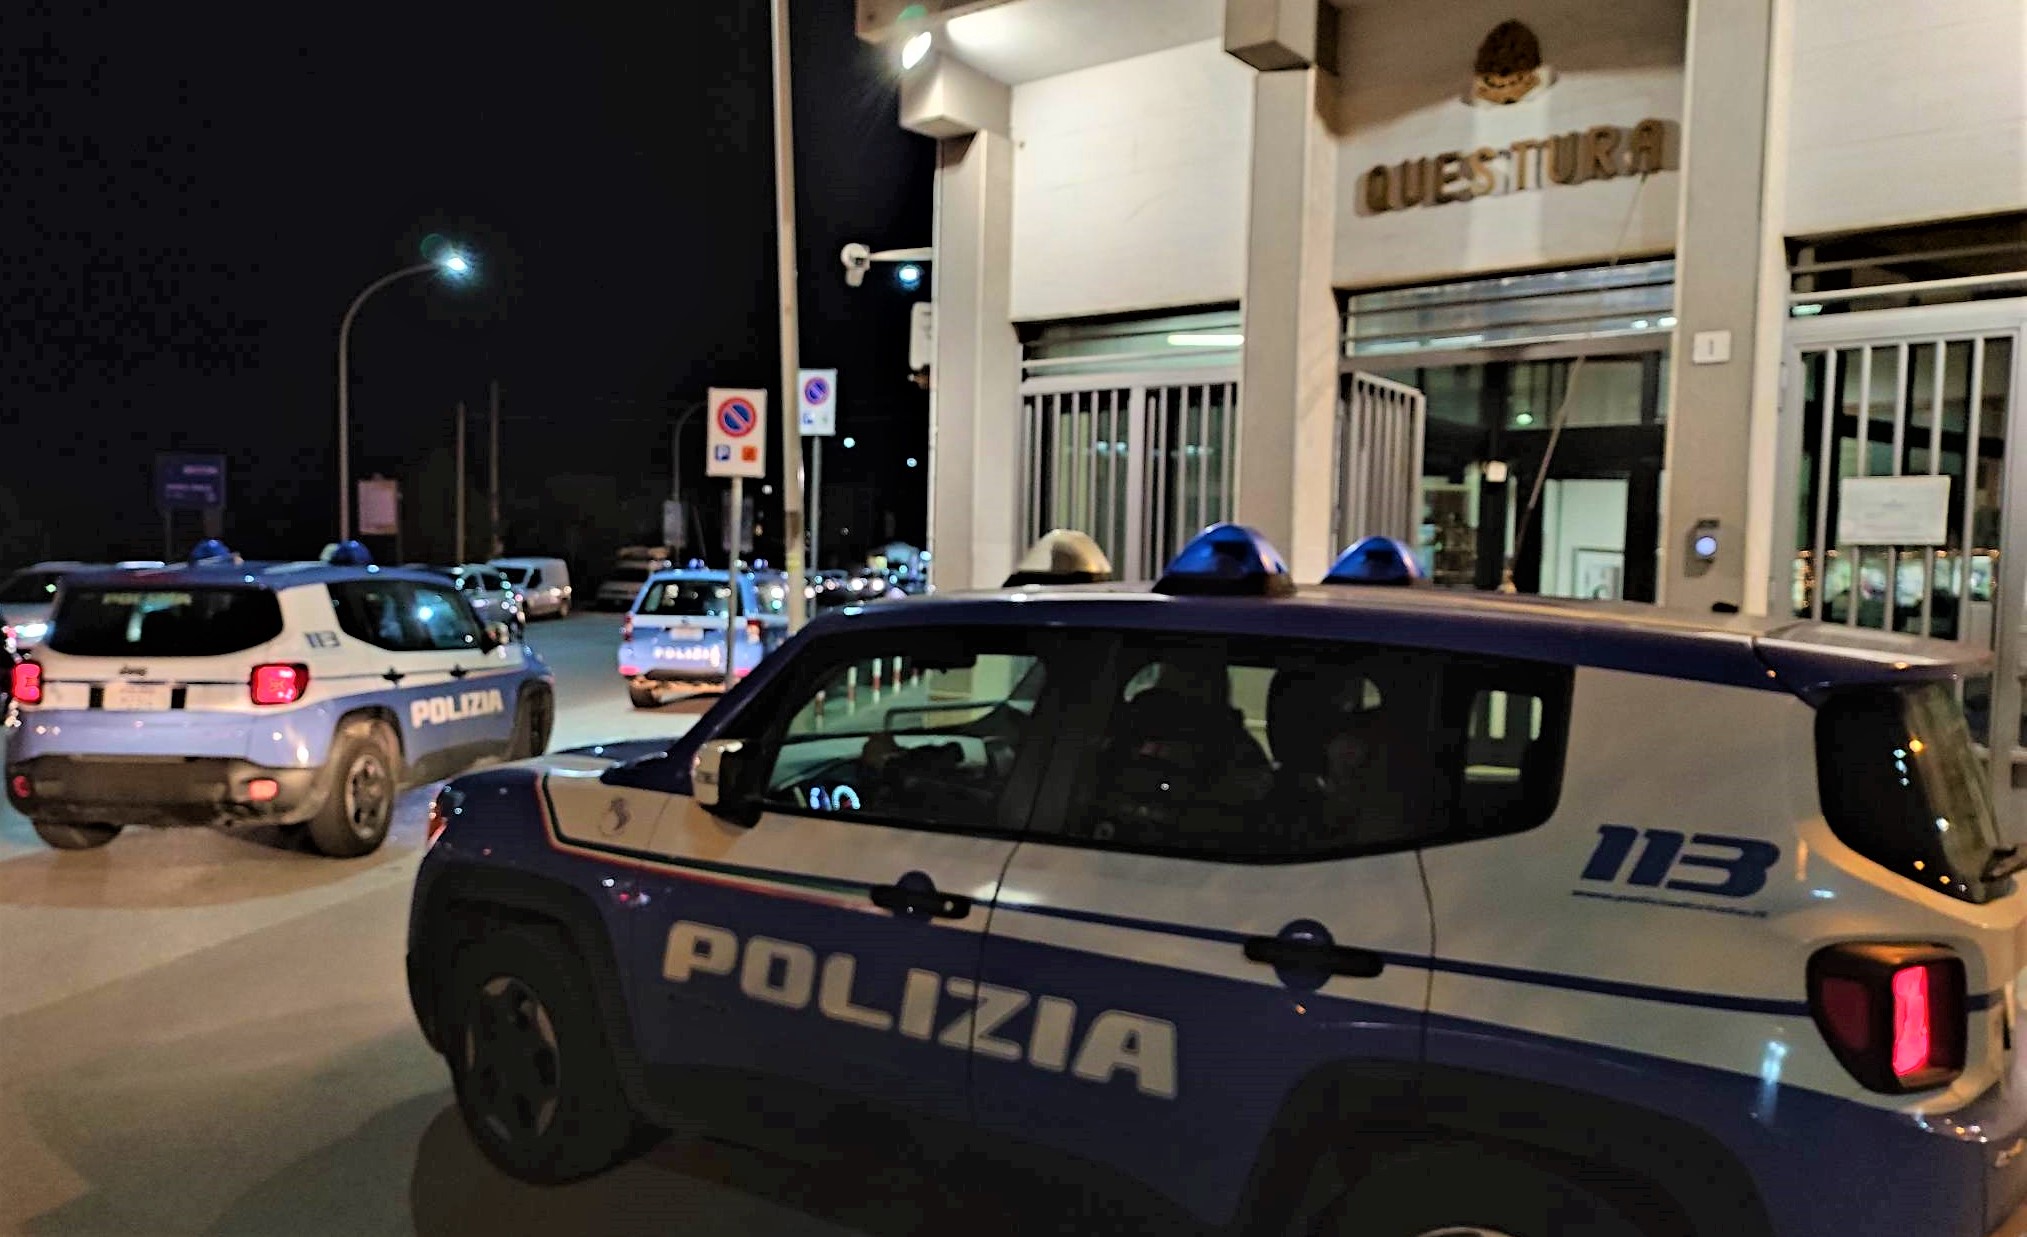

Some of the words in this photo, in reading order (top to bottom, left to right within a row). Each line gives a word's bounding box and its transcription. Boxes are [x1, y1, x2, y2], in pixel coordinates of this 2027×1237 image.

[1360, 118, 1672, 214] QUESTURA
[305, 630, 341, 649] 113
[410, 689, 504, 729] POLIZIA
[1580, 823, 1781, 898] 113
[662, 919, 1178, 1100] POLIZIA
